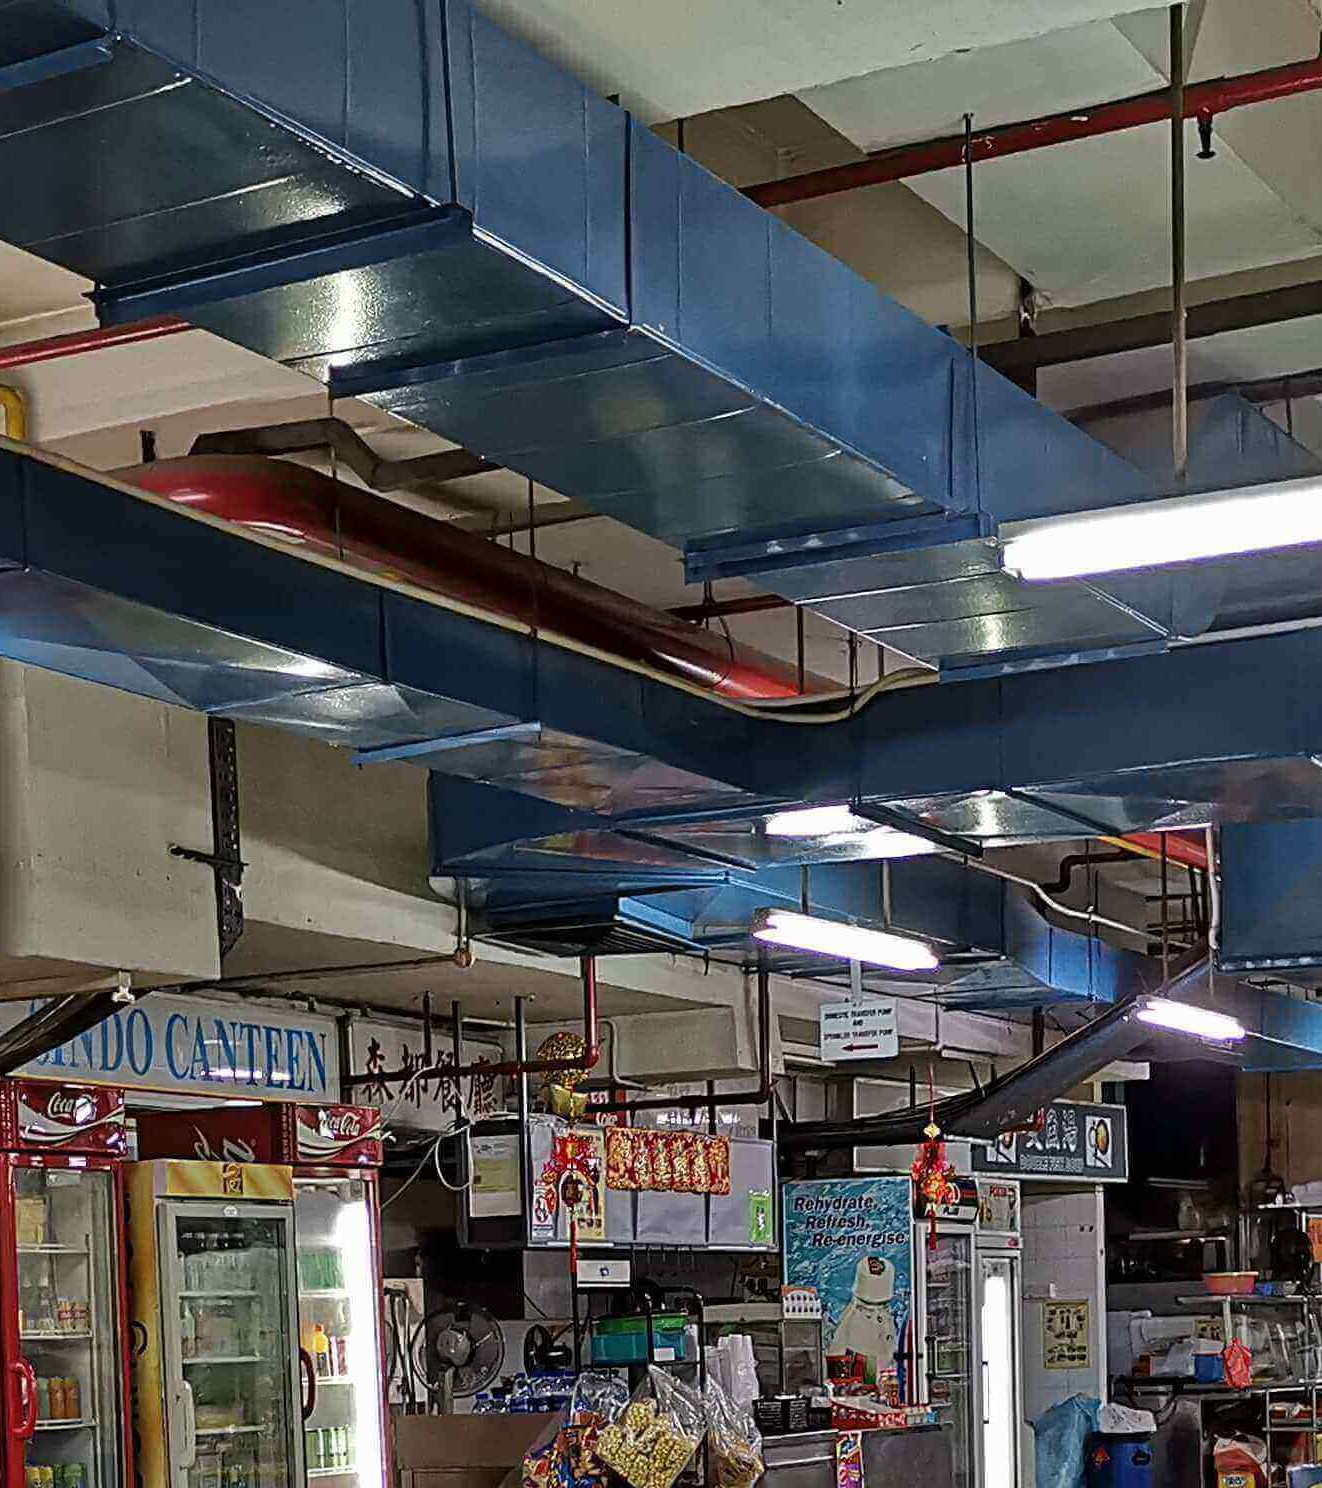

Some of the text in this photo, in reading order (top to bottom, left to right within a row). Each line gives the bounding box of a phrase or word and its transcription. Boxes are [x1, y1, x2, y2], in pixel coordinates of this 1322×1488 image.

[165, 1012, 328, 1092] CANTEEN
[794, 1196, 878, 1213] Rehydrate,
[806, 1215, 871, 1231] Refresh,
[812, 1232, 905, 1248] Re-energise
